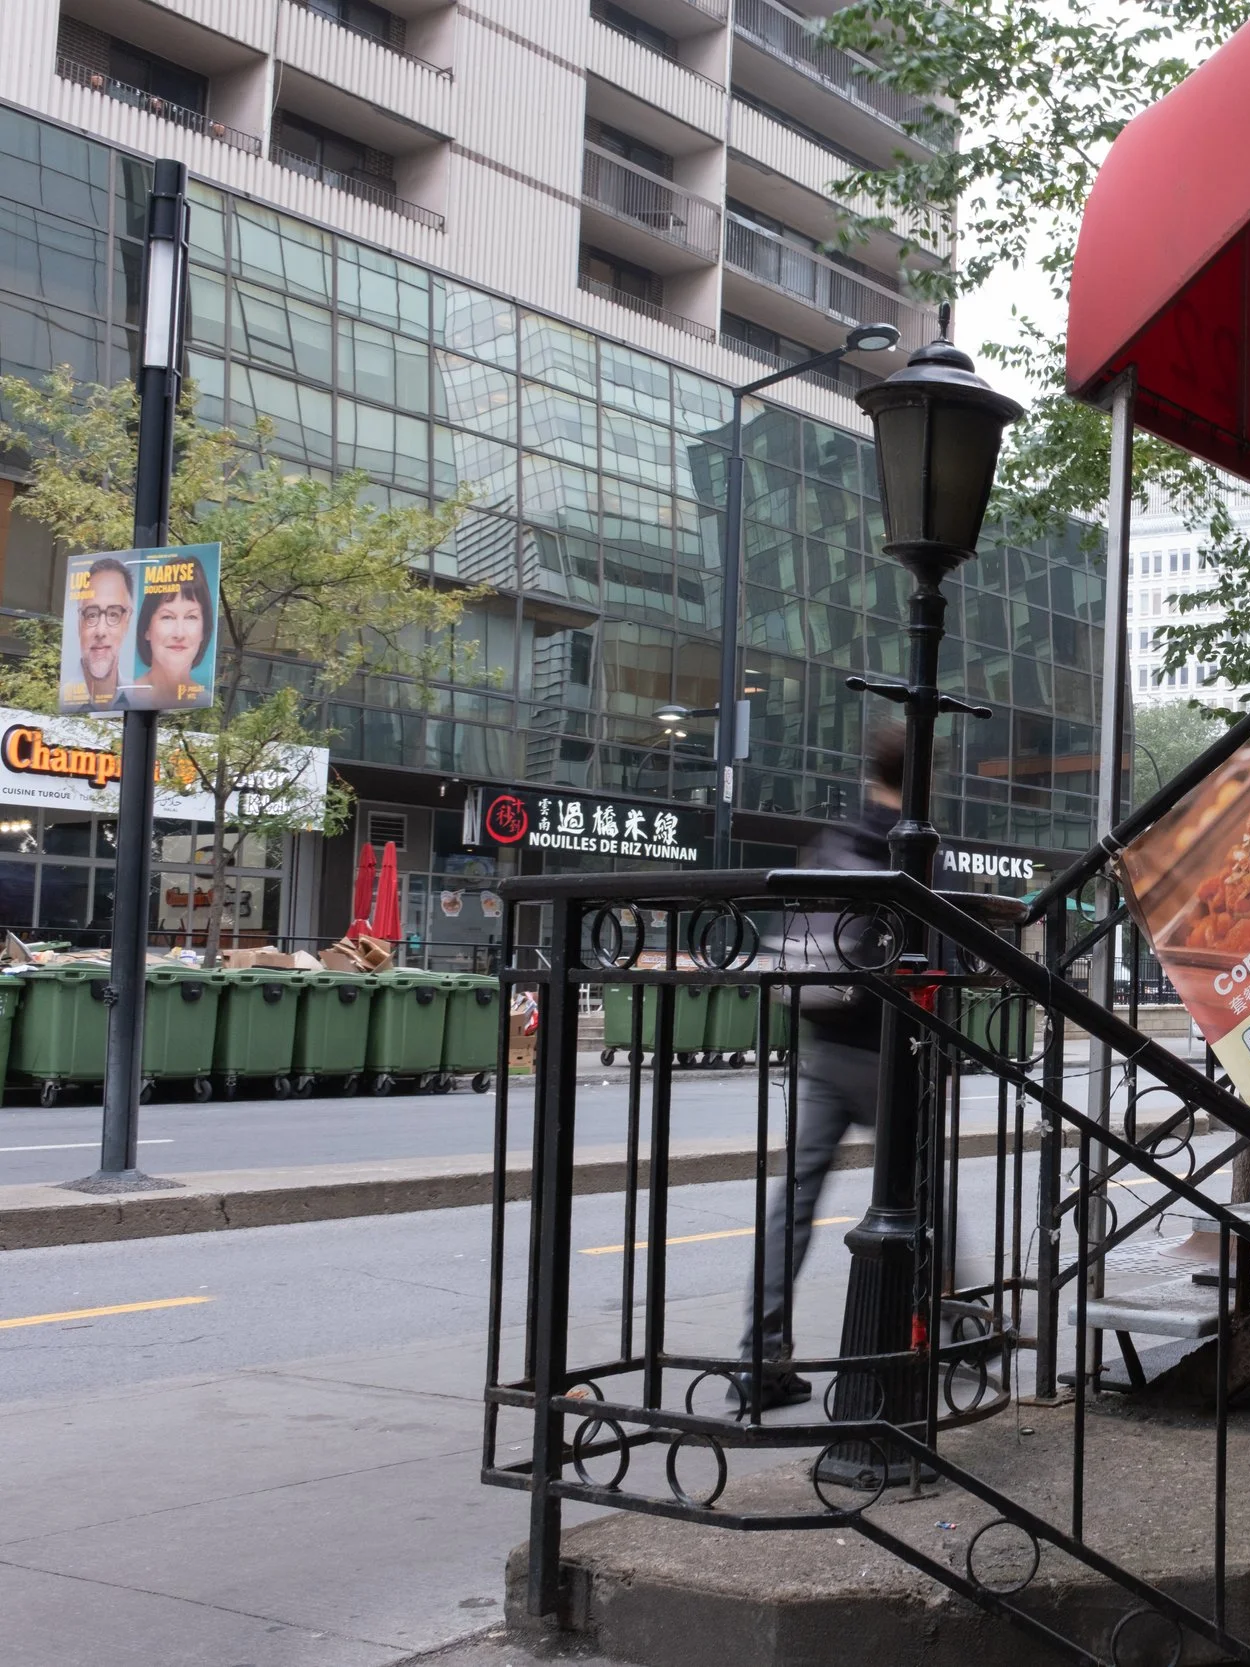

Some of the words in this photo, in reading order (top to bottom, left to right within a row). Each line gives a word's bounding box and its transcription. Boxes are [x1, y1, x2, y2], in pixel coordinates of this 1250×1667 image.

[70, 572, 90, 589] LUC
[144, 563, 195, 583] MARYSE
[2, 787, 36, 797] CUISINE
[38, 790, 71, 800] TURQUE
[557, 799, 679, 845] 過橋米線
[529, 832, 597, 852] NOUILLES
[600, 838, 618, 854] DE
[621, 841, 641, 855] RIZ
[645, 843, 698, 862] YUNNAN
[939, 850, 1034, 879] ARBUCKS
